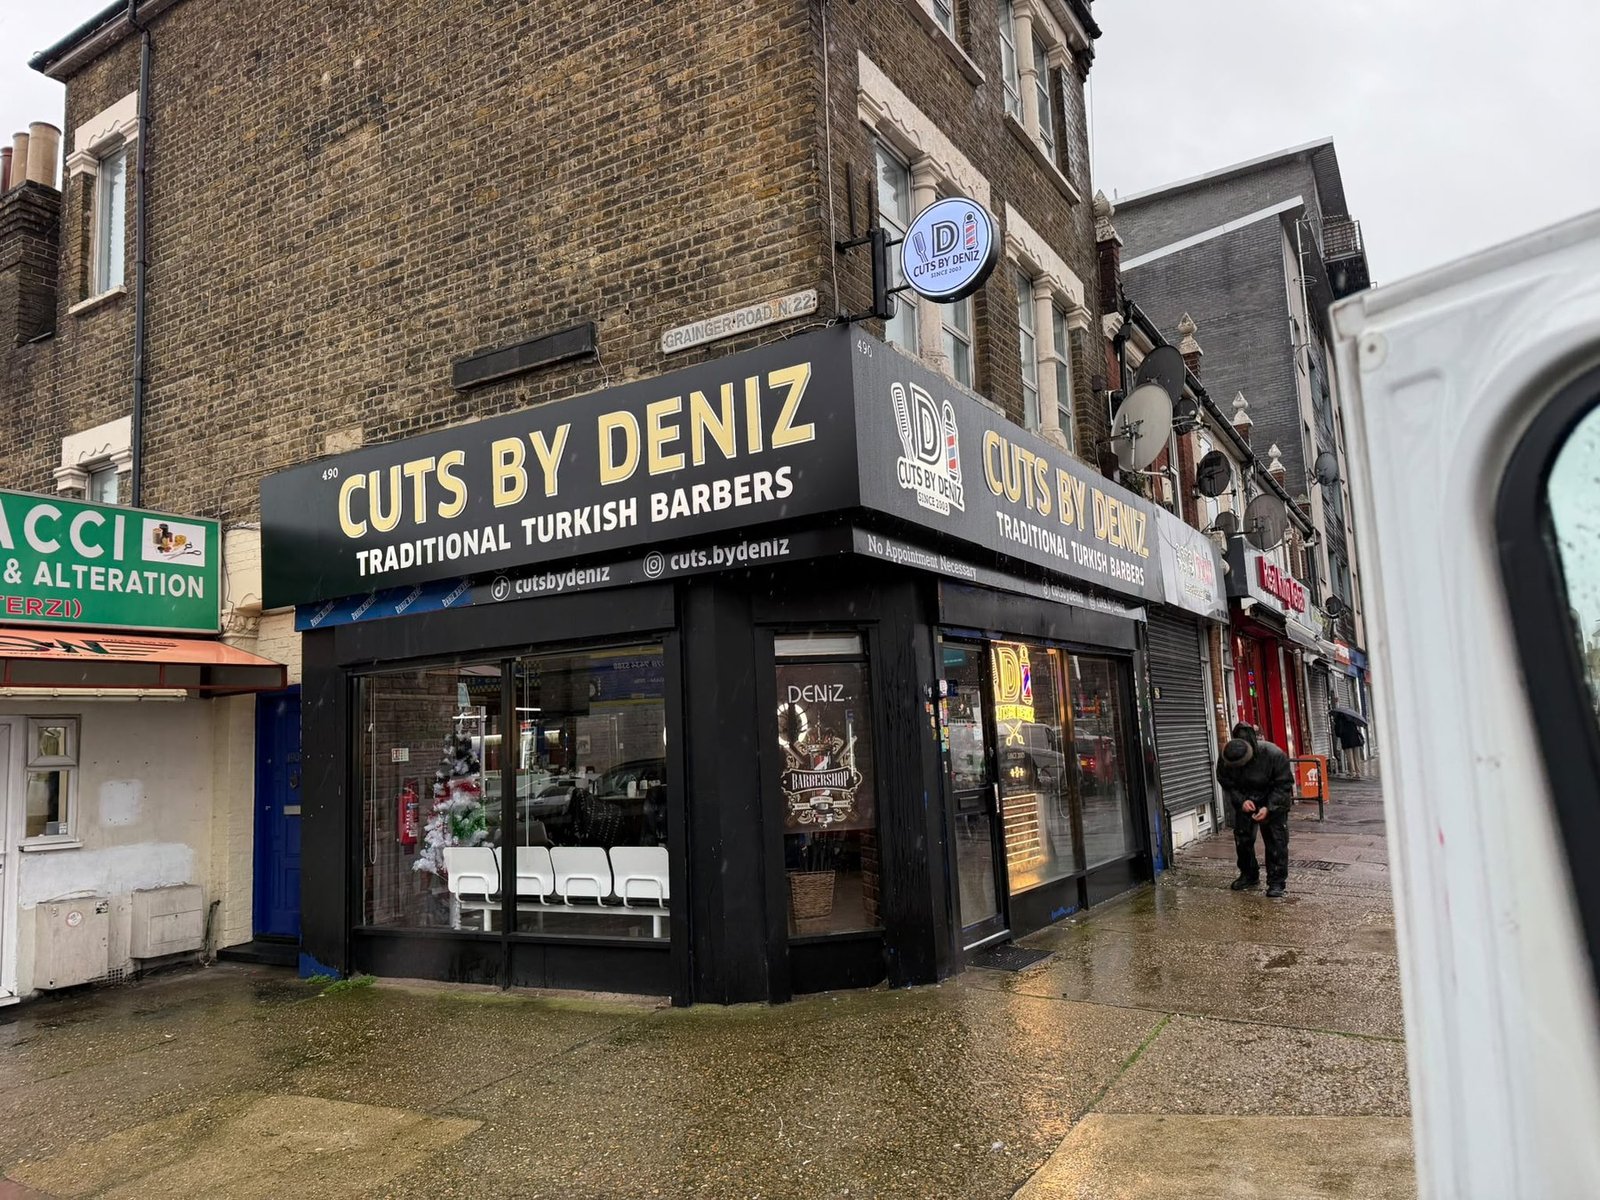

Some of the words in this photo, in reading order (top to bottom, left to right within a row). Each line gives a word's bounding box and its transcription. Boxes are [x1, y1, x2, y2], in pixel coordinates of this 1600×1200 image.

[913, 260, 936, 277] CUTS
[938, 256, 950, 269] BY
[952, 250, 980, 265] DENIZ
[931, 270, 948, 278] SINCE
[665, 317, 732, 348] GRAINGER
[735, 305, 772, 328] ROAD
[856, 339, 873, 358] 490
[338, 450, 469, 539] CUTS
[491, 423, 571, 509] BY
[598, 361, 816, 486] DENIZ
[322, 467, 339, 481] 490
[898, 460, 922, 487] CUTS
[924, 469, 936, 492] BY
[938, 475, 964, 508] DENIZ
[918, 491, 935, 509] SINCE
[982, 429, 1052, 517] CUTS
[1056, 467, 1086, 532] BY
[1091, 487, 1149, 559] DENIZ
[356, 524, 511, 577] TRADITIONAL
[521, 497, 638, 546] TURKISH
[650, 466, 794, 522] BARBERS
[670, 537, 790, 570] cuts.bydeniz
[867, 534, 883, 555] No
[885, 540, 939, 569] Appointment
[940, 555, 977, 581] Necessary
[996, 511, 1069, 561] TRADITIONAL
[1071, 540, 1109, 574] TURKISH
[1110, 557, 1144, 587] BARBERS
[3, 558, 21, 584] &
[33, 561, 204, 599] ALTERATION
[515, 566, 610, 593] cutsbydeniz
[791, 771, 849, 791] BARBERSHOP
